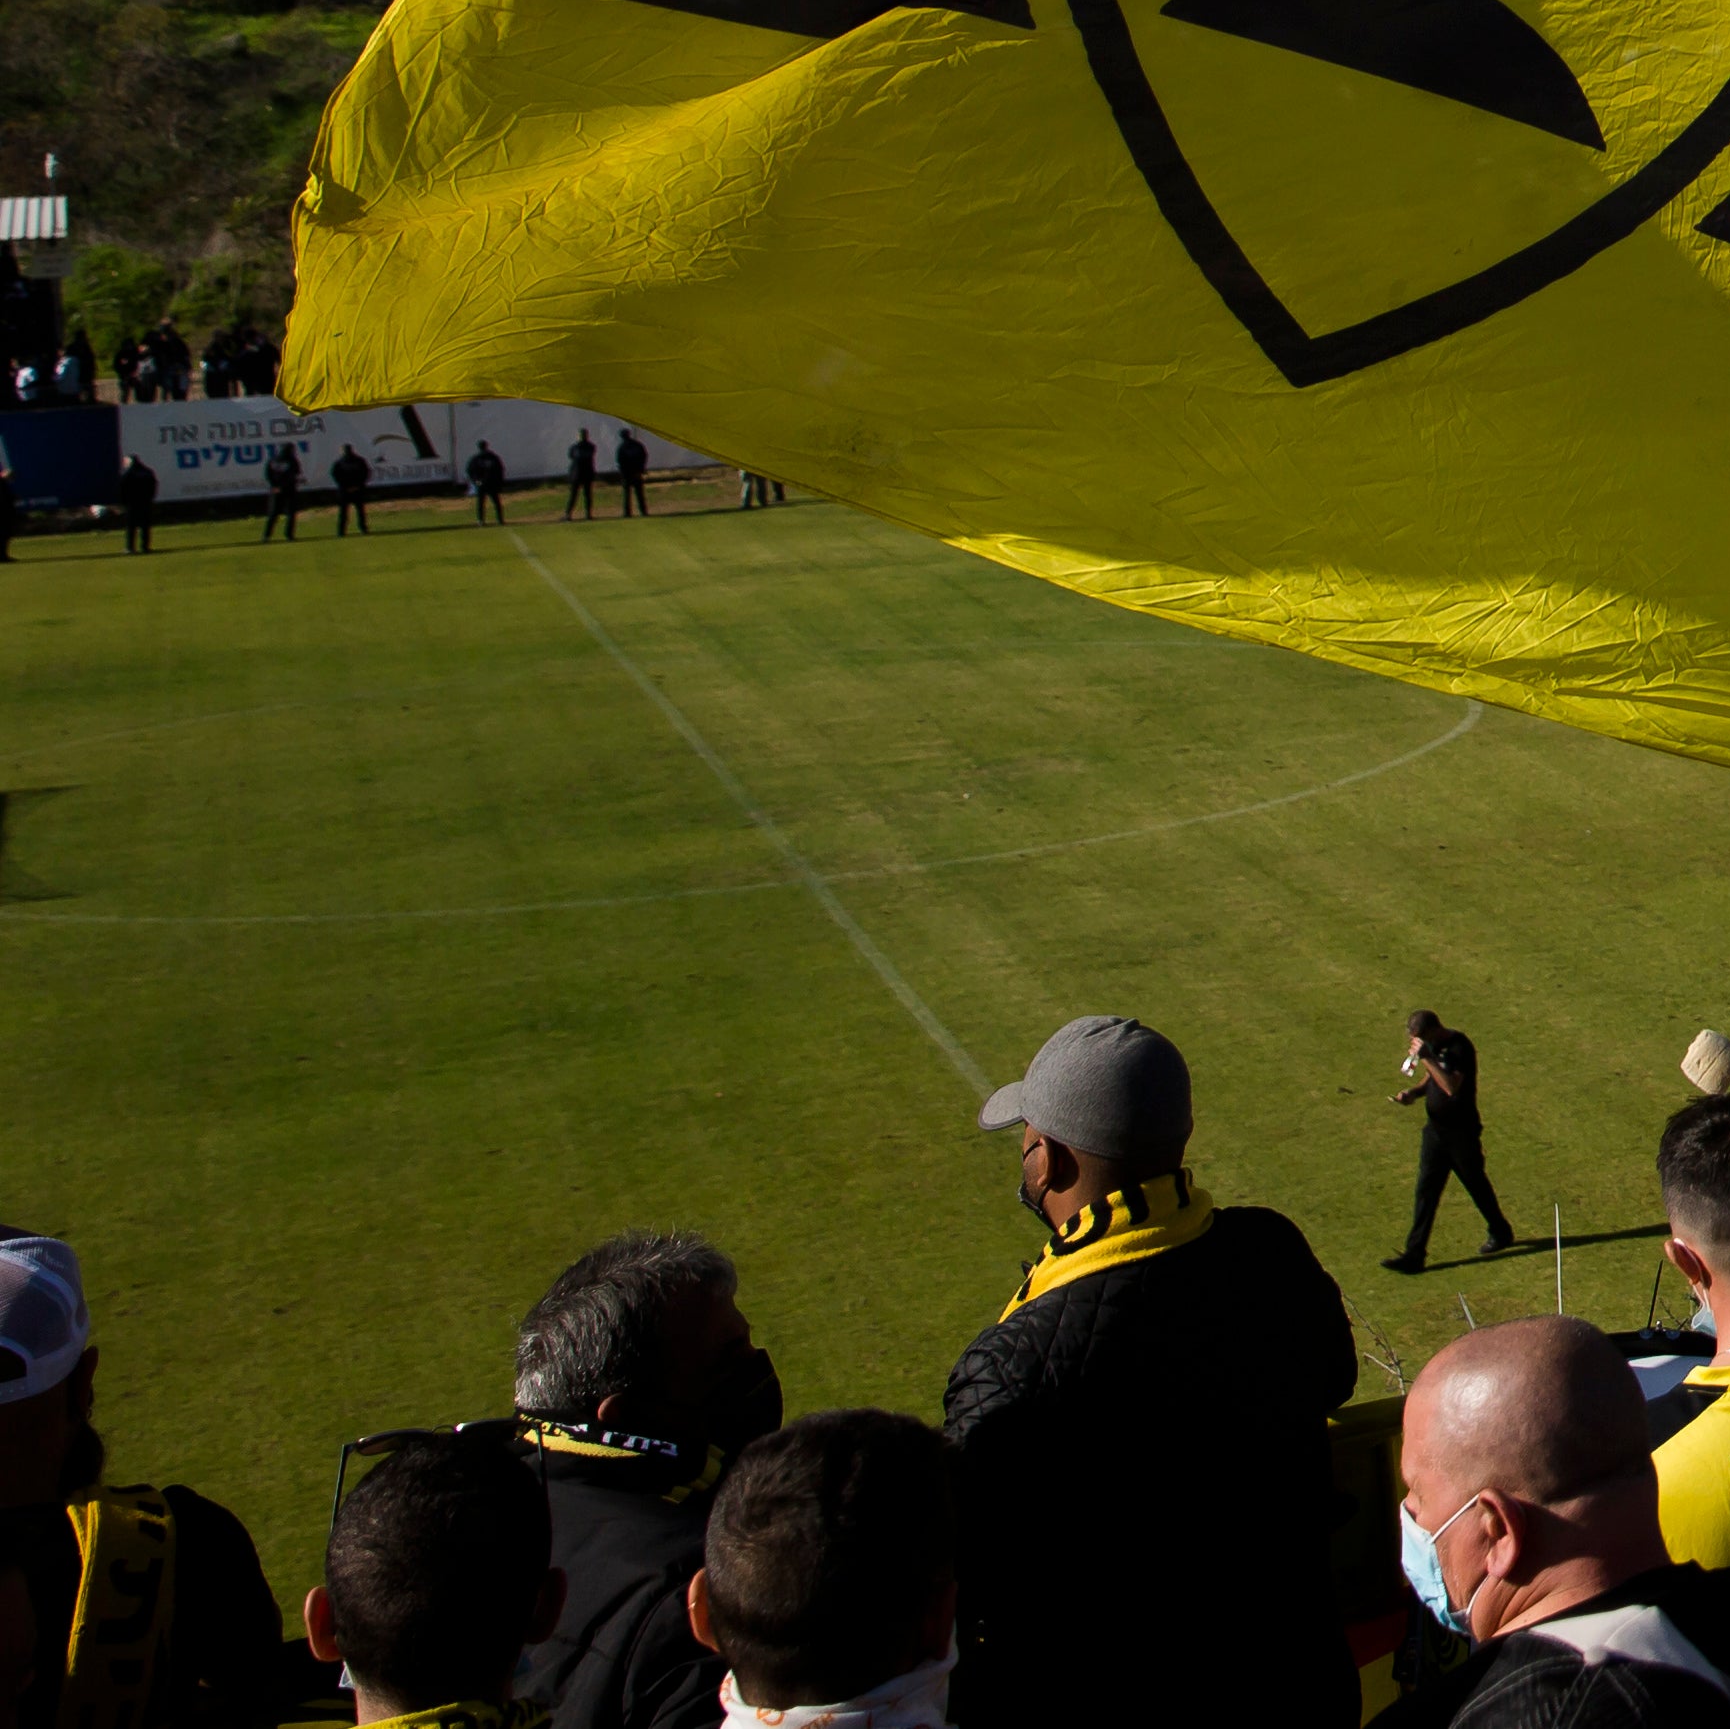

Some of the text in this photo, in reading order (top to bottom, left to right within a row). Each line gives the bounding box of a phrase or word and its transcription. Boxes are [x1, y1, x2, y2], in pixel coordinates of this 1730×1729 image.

[159, 424, 200, 445] את
[207, 419, 263, 441] בונה
[175, 440, 310, 470] יושלים
